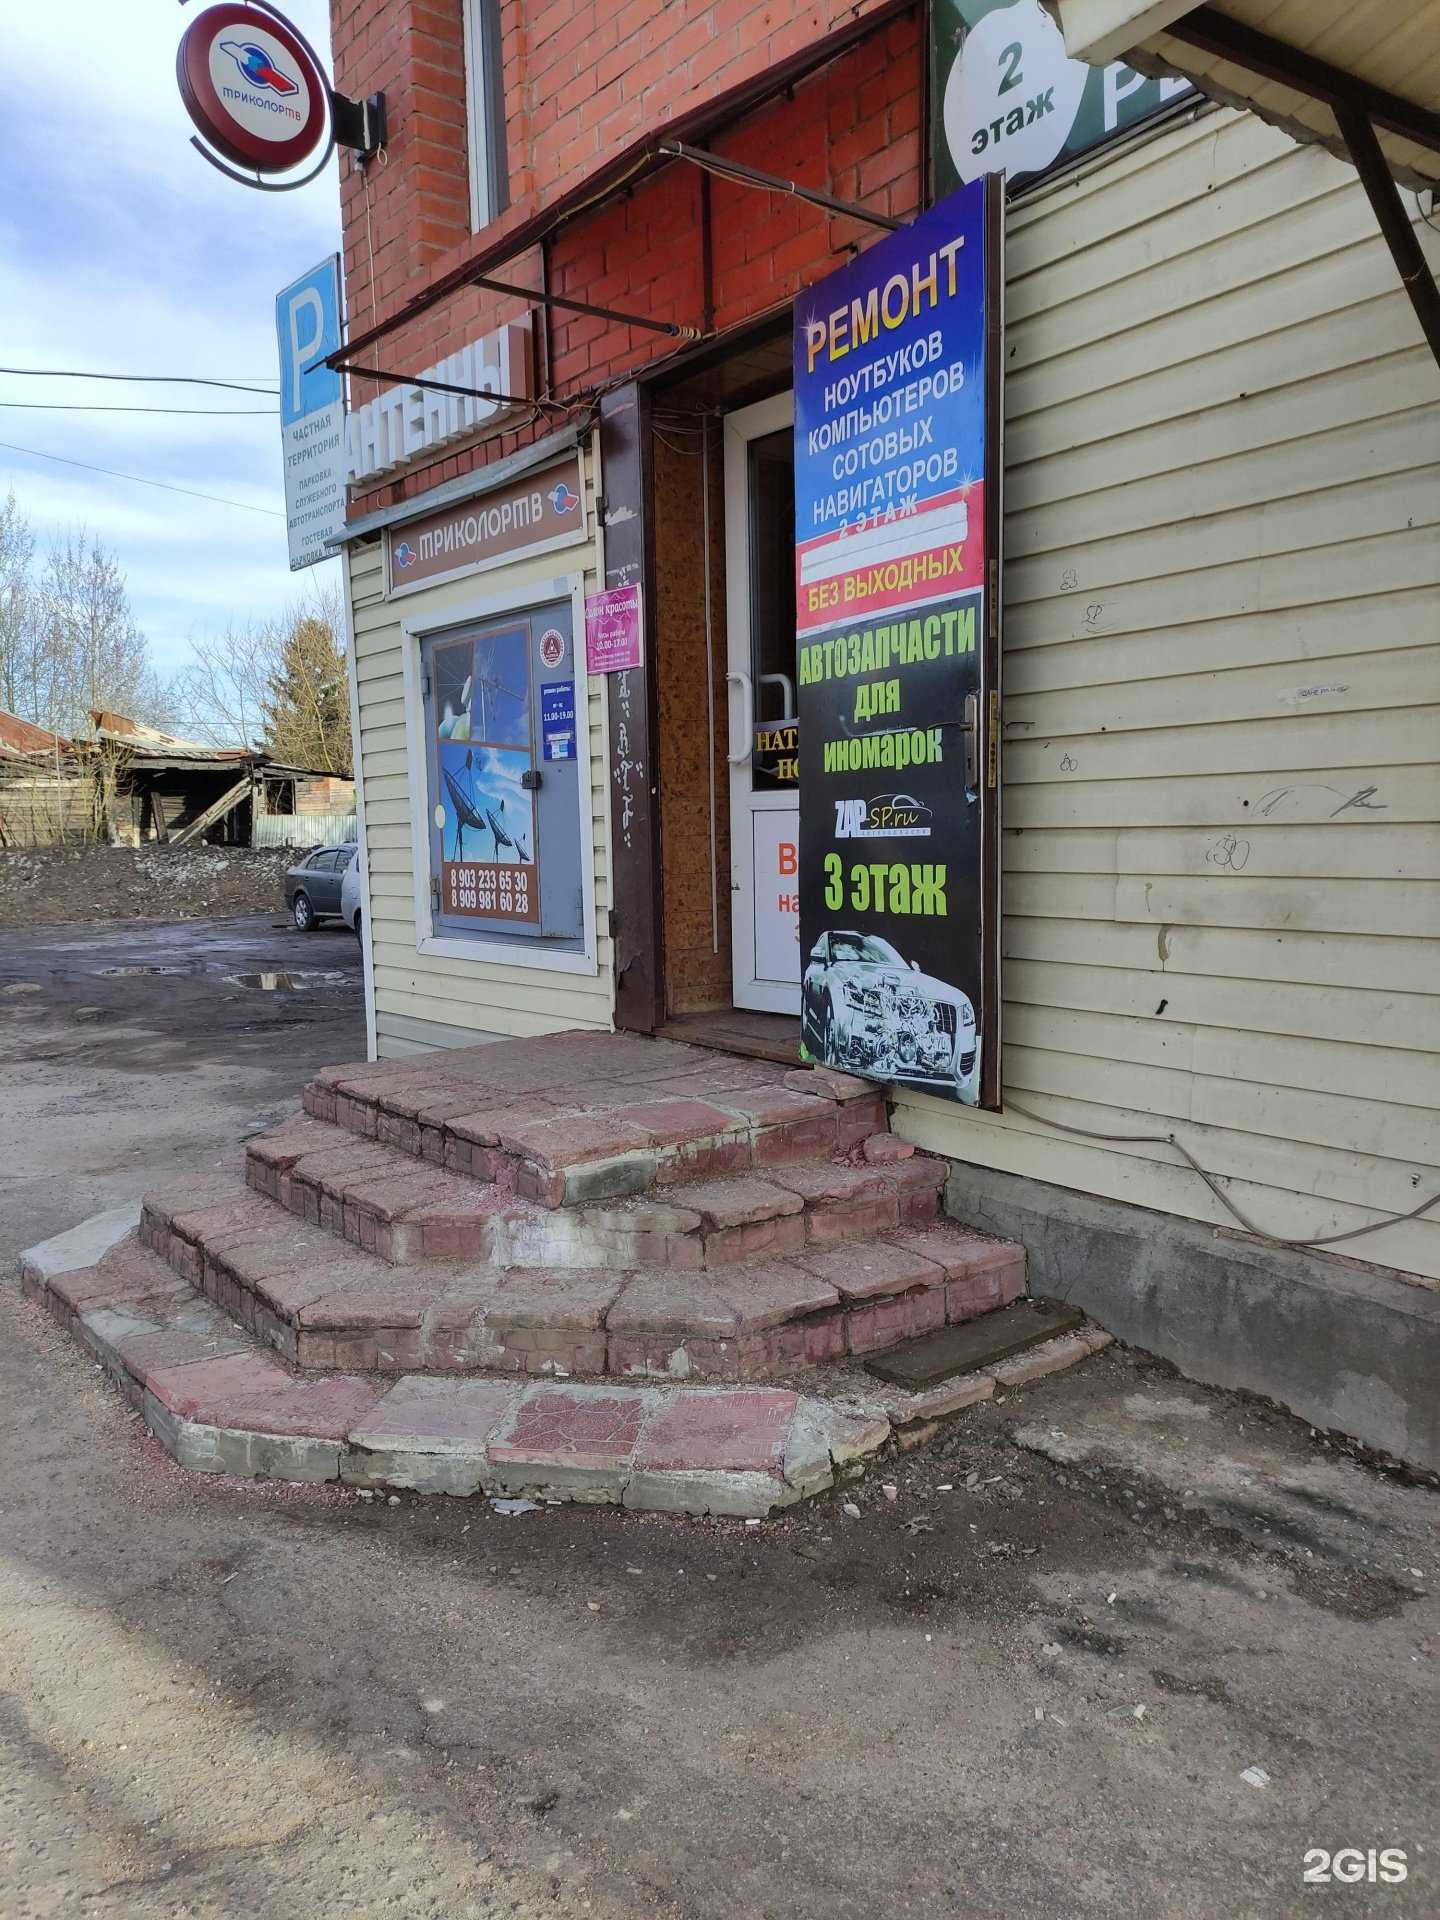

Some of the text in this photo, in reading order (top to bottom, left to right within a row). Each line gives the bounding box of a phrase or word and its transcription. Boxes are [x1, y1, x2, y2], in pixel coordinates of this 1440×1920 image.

[998, 42, 1023, 96] 2
[971, 86, 1055, 155] этаж
[808, 235, 965, 374] РЕМОНТ
[824, 330, 943, 412] НОУТБУКОВ
[293, 414, 331, 441] ЧАСТНАЯ
[809, 361, 965, 456] КОМПЬЮТЕРОВ
[288, 434, 340, 467] ТЕРРИТОРИЯ
[832, 416, 934, 480] СОТОВЫХ
[295, 483, 337, 510] СЛУЖЕБНОГО
[299, 468, 331, 490] ПАРКОВКА
[813, 447, 958, 525] НАВИГАТОРОВ
[289, 496, 345, 528] АВТОТРАНСПОРТА
[839, 518, 848, 539] 2
[808, 545, 964, 612] БЕЗ ВЫХОДНЫХ
[799, 607, 976, 685] АВТОЗАПЧАСТИ
[824, 728, 943, 774] иномарок
[451, 869, 527, 892] 8 903 233 65 30
[452, 889, 528, 913] 8 909 981 60 28
[824, 852, 948, 916] 3 этаж
